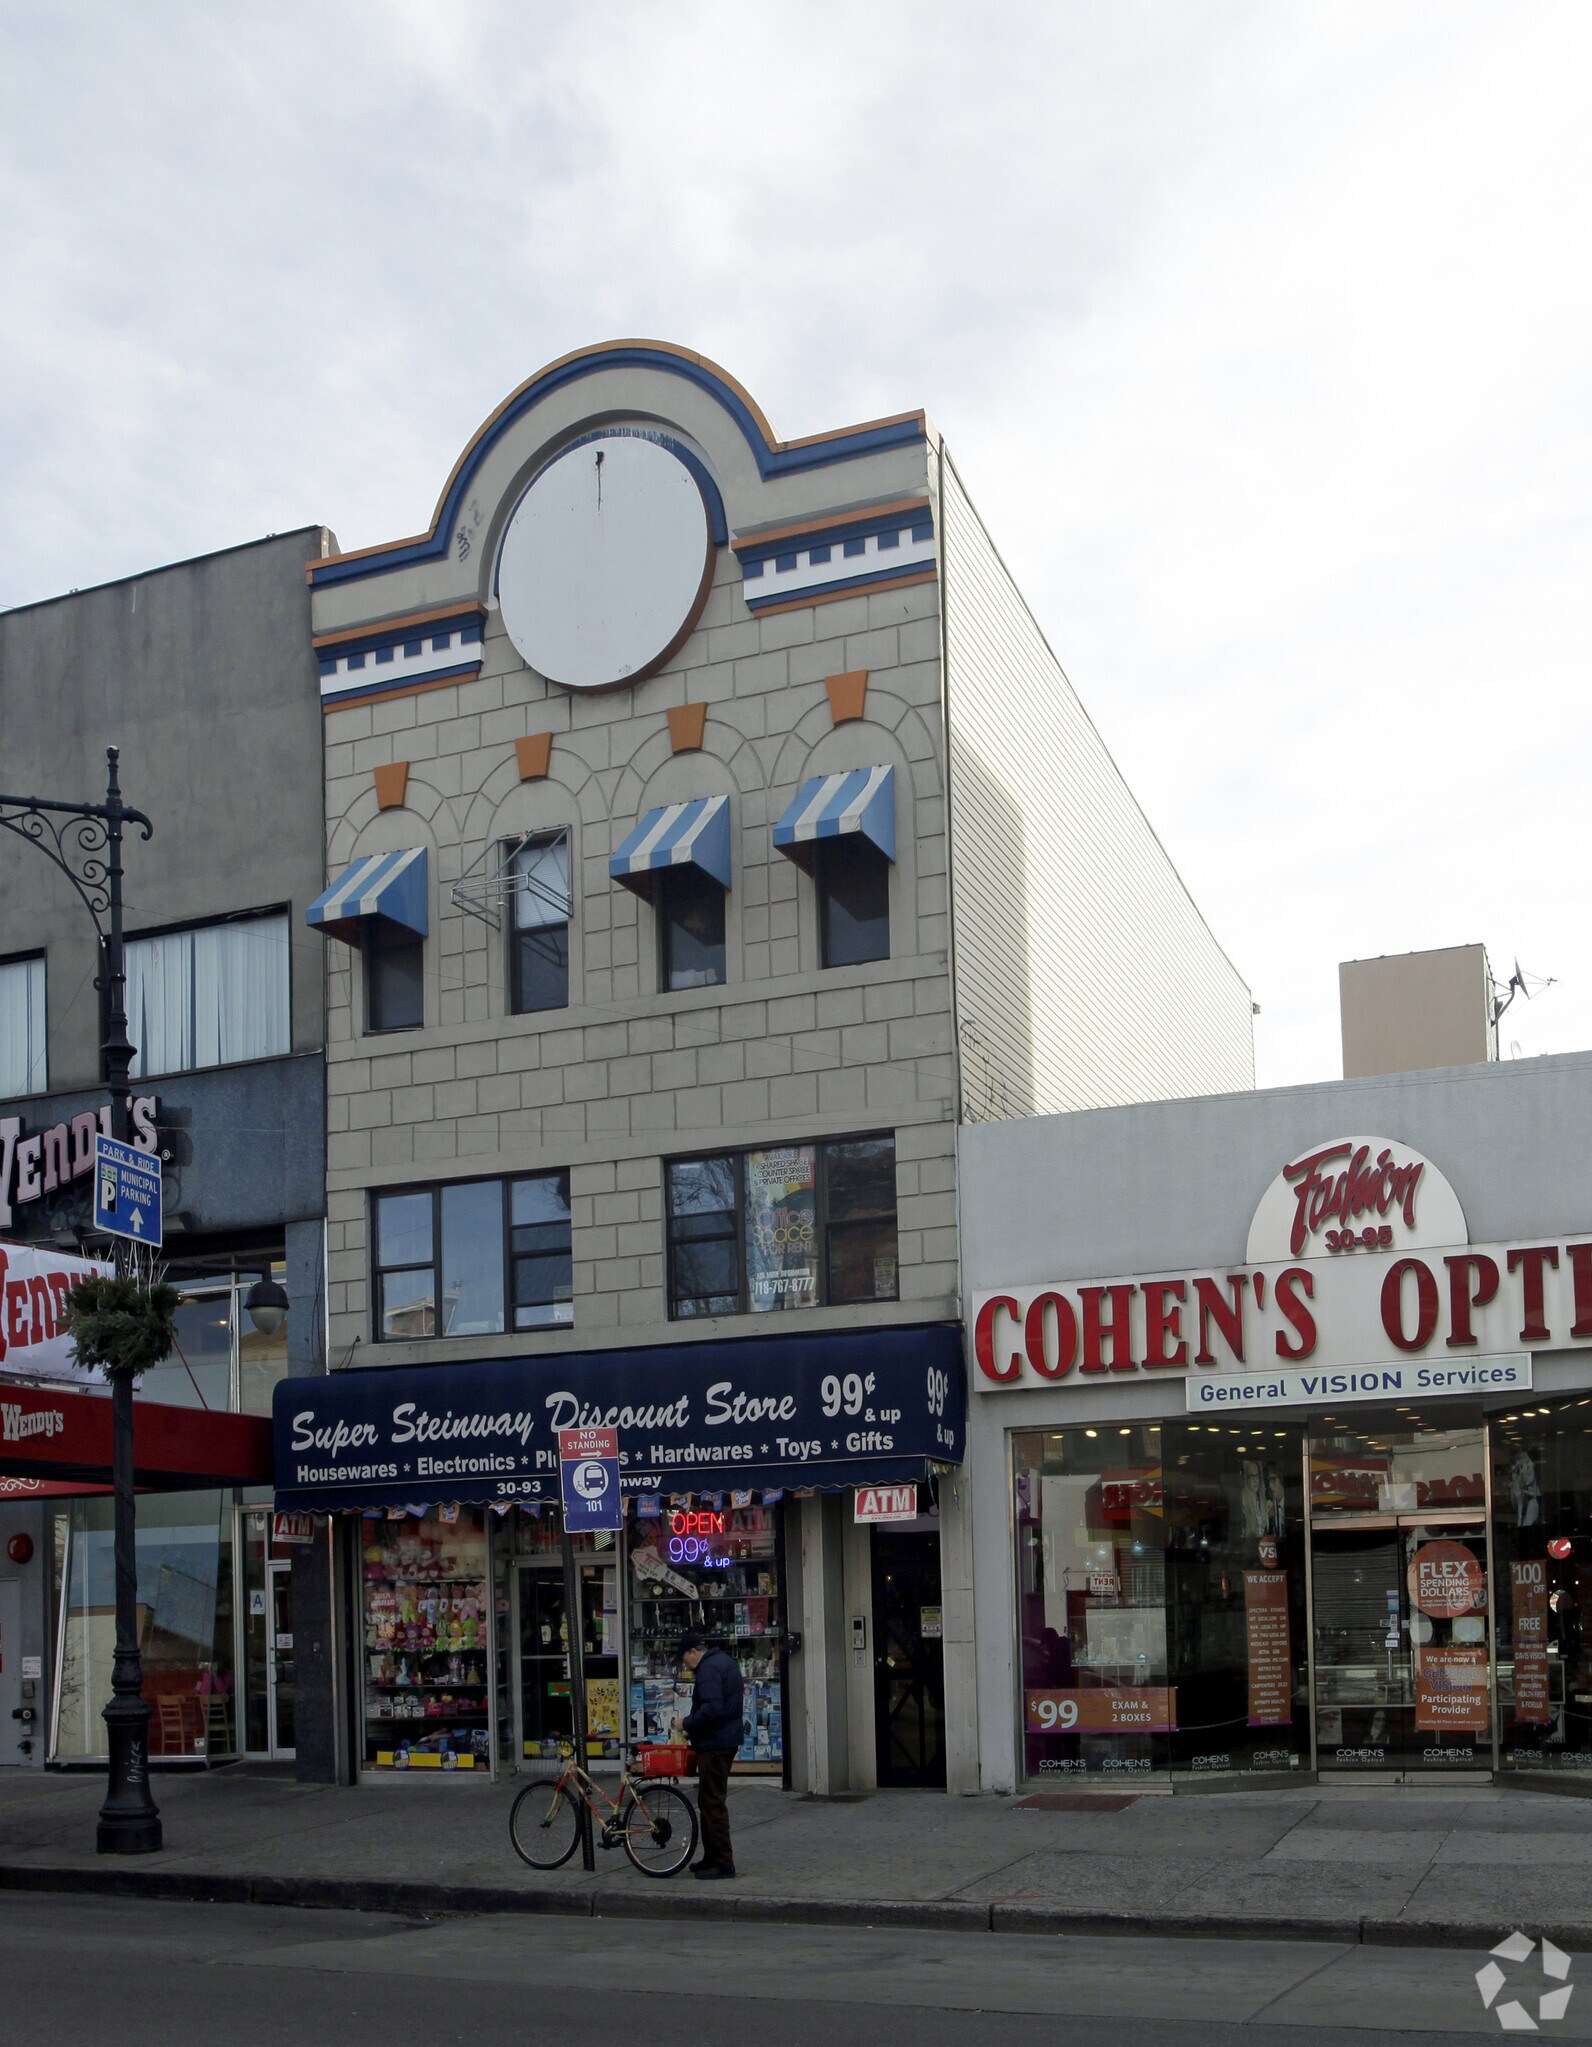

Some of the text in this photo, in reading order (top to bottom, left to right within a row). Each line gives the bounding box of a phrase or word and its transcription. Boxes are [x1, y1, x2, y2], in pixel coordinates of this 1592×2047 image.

[102, 1143, 155, 1172] PARK & RIDE
[760, 1157, 808, 1170] SHARED SPACE
[757, 1165, 809, 1177] COUNTER SPACE
[121, 1170, 158, 1194] MUNICIPAL
[759, 1177, 783, 1185] PRIVATE
[784, 1174, 811, 1183] OFFICES
[101, 1178, 116, 1211] P
[120, 1185, 151, 1207] PARKING
[1282, 1142, 1425, 1257] Fashion
[757, 1208, 813, 1229] Office
[753, 1225, 813, 1249] Space
[1324, 1225, 1393, 1252] 30-95
[764, 1241, 812, 1256] FOR RENT
[754, 1277, 815, 1296] 718-767-8777
[974, 1267, 1317, 1382] COHEN'S
[927, 1366, 949, 1416] 99¢
[1200, 1366, 1517, 1402] General VISION Services
[291, 1371, 902, 1458] Super Steinway Discount Store 99¢ & up
[580, 1431, 596, 1440] NO
[937, 1424, 955, 1450] & up
[567, 1439, 610, 1450] STANDING
[297, 1463, 398, 1483] Housewares
[417, 1453, 516, 1475] Electronics
[650, 1442, 754, 1464] Hardwares
[776, 1438, 822, 1461] Toys
[846, 1431, 895, 1453] Gifts
[496, 1480, 542, 1494] 30-93
[586, 1499, 603, 1512] 101
[863, 1488, 911, 1513] ATM
[279, 1514, 311, 1535] ATM
[671, 1512, 723, 1535] OPEN
[669, 1536, 709, 1562] 99¢
[703, 1556, 730, 1568] & up
[1420, 1561, 1469, 1579] FLEX
[1511, 1563, 1542, 1585] $100
[1247, 1575, 1284, 1583] WE ACCEPT
[1420, 1578, 1470, 1587] SPENDING
[1420, 1587, 1470, 1597] DOLLARS
[1533, 1585, 1545, 1594] OFF
[253, 1594, 263, 1608] A
[1518, 1617, 1541, 1631] FREE
[1425, 1655, 1438, 1663] We
[1423, 1667, 1477, 1678] GENERAL
[1430, 1680, 1473, 1691] VISION
[1421, 1694, 1482, 1706] Participating
[1517, 1690, 1534, 1698] HEALTH
[1112, 1701, 1149, 1709] EXAM &
[1431, 1705, 1471, 1714] Provider
[1031, 1700, 1079, 1729] $99
[1112, 1713, 1152, 1722] 2 BOXES
[1192, 1754, 1229, 1765] COHEN'S
[1253, 1750, 1289, 1760] COHEN'S
[1336, 1748, 1384, 1757] COHEN'S
[1423, 1748, 1473, 1757] COHEN'S
[1039, 1759, 1087, 1768] COHEN'S
[1102, 1758, 1151, 1768] COHEN'S
